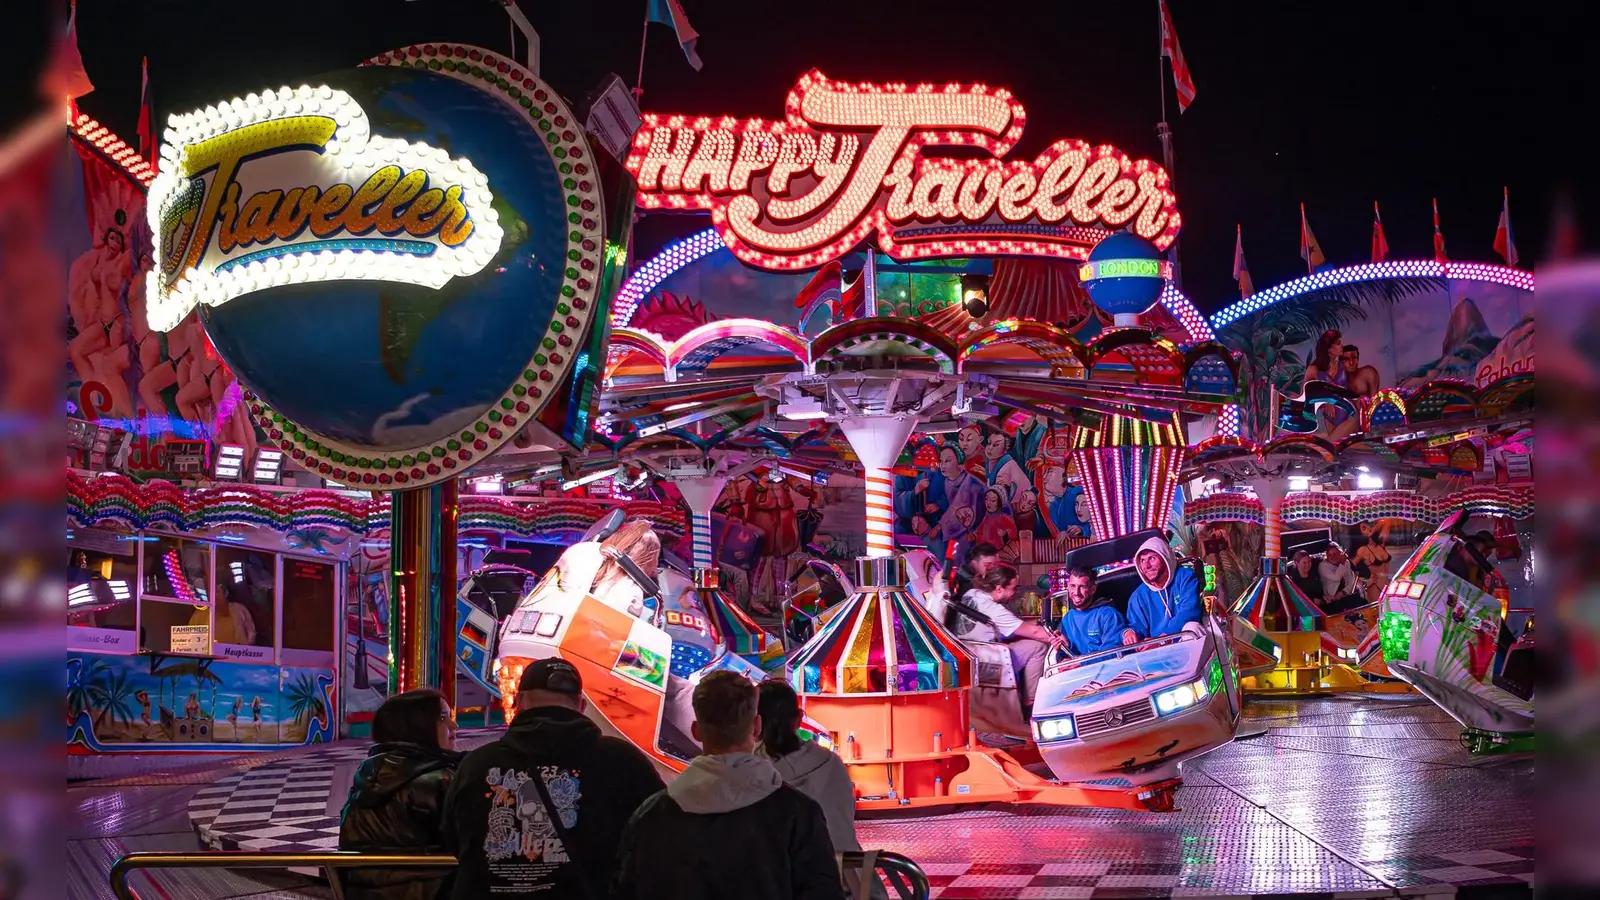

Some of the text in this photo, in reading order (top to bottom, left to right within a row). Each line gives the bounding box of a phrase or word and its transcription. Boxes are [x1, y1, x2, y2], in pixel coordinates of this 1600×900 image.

[162, 115, 476, 288] Traveller
[636, 90, 1172, 251] HAPPY Traveller
[1099, 261, 1158, 275] LONDON
[224, 647, 264, 658] Hauptkasse
